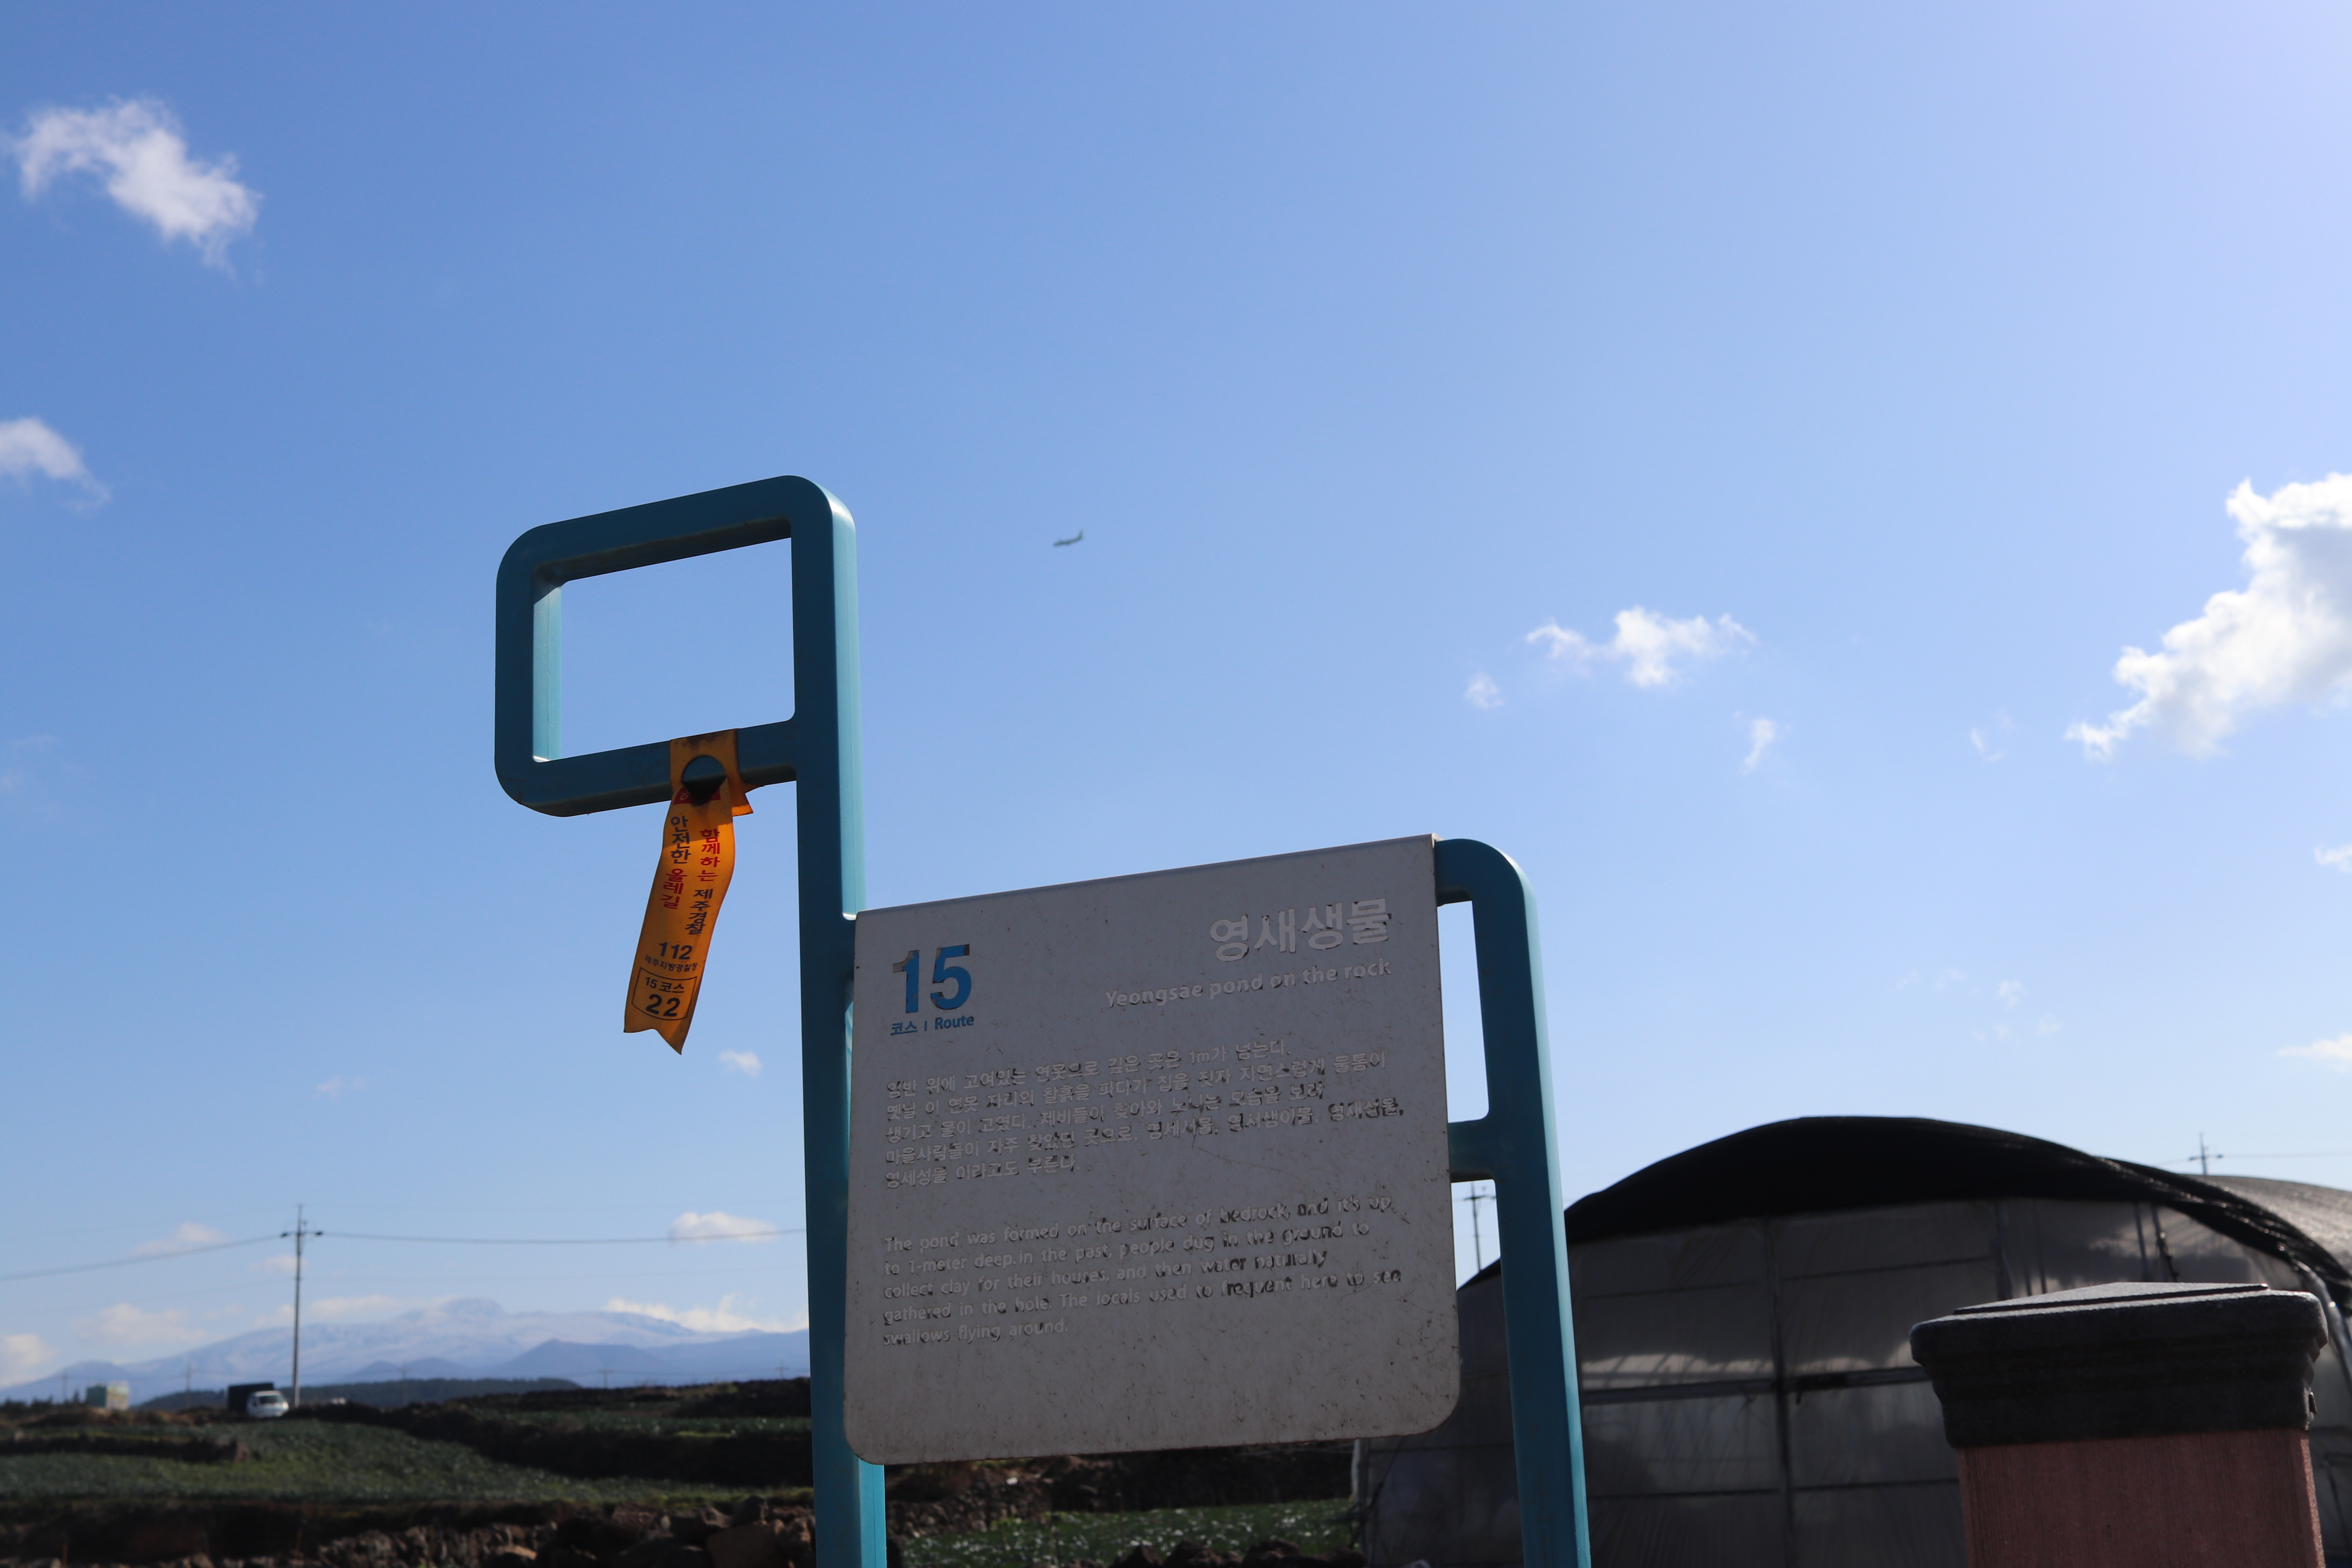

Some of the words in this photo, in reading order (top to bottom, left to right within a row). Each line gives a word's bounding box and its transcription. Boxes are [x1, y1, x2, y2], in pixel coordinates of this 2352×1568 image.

[671, 816, 691, 864] 안전한
[697, 829, 720, 881] 함께하는
[661, 868, 687, 909] 올레길
[685, 889, 713, 935] 제주경찰
[659, 942, 693, 960] 112
[1210, 898, 1392, 962] 영새생물
[645, 955, 698, 972] 제주지방경찰청
[646, 977, 658, 988] 15
[659, 982, 684, 993] 코스
[892, 944, 972, 1014] 15
[1105, 984, 1203, 1007] Yeongsae
[1209, 972, 1263, 1000] pond
[1269, 973, 1296, 989] on
[1302, 965, 1338, 985] the
[1344, 957, 1392, 980] rock
[646, 994, 680, 1017] 22
[890, 1021, 918, 1035] 코스
[935, 1016, 974, 1029] Route
[887, 1080, 917, 1098] 암반
[926, 1075, 956, 1094] 위에
[964, 1069, 1027, 1089] 고여있는
[1035, 1060, 1100, 1082] 연못으로
[1108, 1054, 1140, 1074] 깊은
[1148, 1051, 1181, 1070] 곳은
[1189, 1045, 1227, 1064] 1m가
[1236, 1039, 1291, 1060] 넘는다.
[887, 1102, 917, 1121] 옛날
[925, 1100, 939, 1116] 이
[948, 1095, 979, 1114] 연못
[986, 1089, 1034, 1109] 자리의
[1043, 1083, 1091, 1105] 찰흙을
[1098, 1077, 1148, 1098] 파다가
[1157, 1072, 1189, 1093] 집을
[1198, 1068, 1232, 1088] 짓자
[1239, 1057, 1325, 1083] 자연스럽게
[1333, 1051, 1385, 1073] 물통이
[886, 1124, 932, 1143] 생기고
[940, 1119, 971, 1138] 물이
[978, 1112, 1032, 1132] 고였다.
[1040, 1104, 1105, 1127] 제비들이
[1113, 1098, 1163, 1120] 찾아와
[1170, 1093, 1221, 1113] 노니는
[1229, 1085, 1281, 1107] 모습을
[1289, 1081, 1323, 1101] 보러
[886, 1140, 980, 1166] 마을사람들이
[987, 1136, 1020, 1156] 자주
[1027, 1130, 1076, 1152] 찾았던
[1083, 1125, 1138, 1147] 곳으로,
[956, 1160, 1019, 1181] 이라고도
[1027, 1154, 1081, 1175] 부른다.
[884, 1237, 912, 1252] The
[920, 1231, 958, 1253] pond
[967, 1232, 996, 1245] was
[1003, 1221, 1058, 1242] formed
[1067, 1225, 1087, 1237] on
[1096, 1217, 1122, 1234] the
[1130, 1213, 1187, 1232] surface
[1195, 1209, 1212, 1225] of
[1220, 1202, 1290, 1224] bedrock,
[1297, 1197, 1328, 1216] and
[1337, 1196, 1360, 1212] it's
[1369, 1196, 1391, 1213] up
[884, 1261, 900, 1275] to
[909, 1258, 967, 1274] 1-meter
[1042, 1246, 1067, 1262] the
[1076, 1243, 1112, 1263] past,
[1120, 1237, 1174, 1259] people
[1183, 1234, 1214, 1252] dug
[1223, 1232, 1238, 1247] in
[1247, 1228, 1274, 1245] the
[1283, 1221, 1343, 1245] ground
[1352, 1222, 1369, 1236] to
[884, 1282, 933, 1299] collect
[941, 1278, 971, 1295] clay
[978, 1276, 999, 1291] for
[1007, 1273, 1042, 1289] their
[1052, 1270, 1110, 1285] houses,
[1117, 1263, 1147, 1281] and
[1154, 1260, 1192, 1277] then
[1200, 1257, 1246, 1274] water
[1255, 1248, 1327, 1269] naturally
[884, 1303, 951, 1326] gathered
[959, 1302, 973, 1316] in
[982, 1299, 1007, 1315] the
[1015, 1295, 1052, 1312] hole.
[1058, 1293, 1088, 1309] The
[1096, 1288, 1140, 1305] locals
[1149, 1284, 1187, 1302] used
[1196, 1283, 1213, 1298] to
[1220, 1276, 1292, 1297] frequent
[1301, 1273, 1338, 1290] here
[1346, 1270, 1365, 1286] to
[1373, 1269, 1401, 1284] see
[884, 1328, 950, 1347] swallows
[958, 1324, 1000, 1343] flying
[1009, 1318, 1068, 1338] around.
